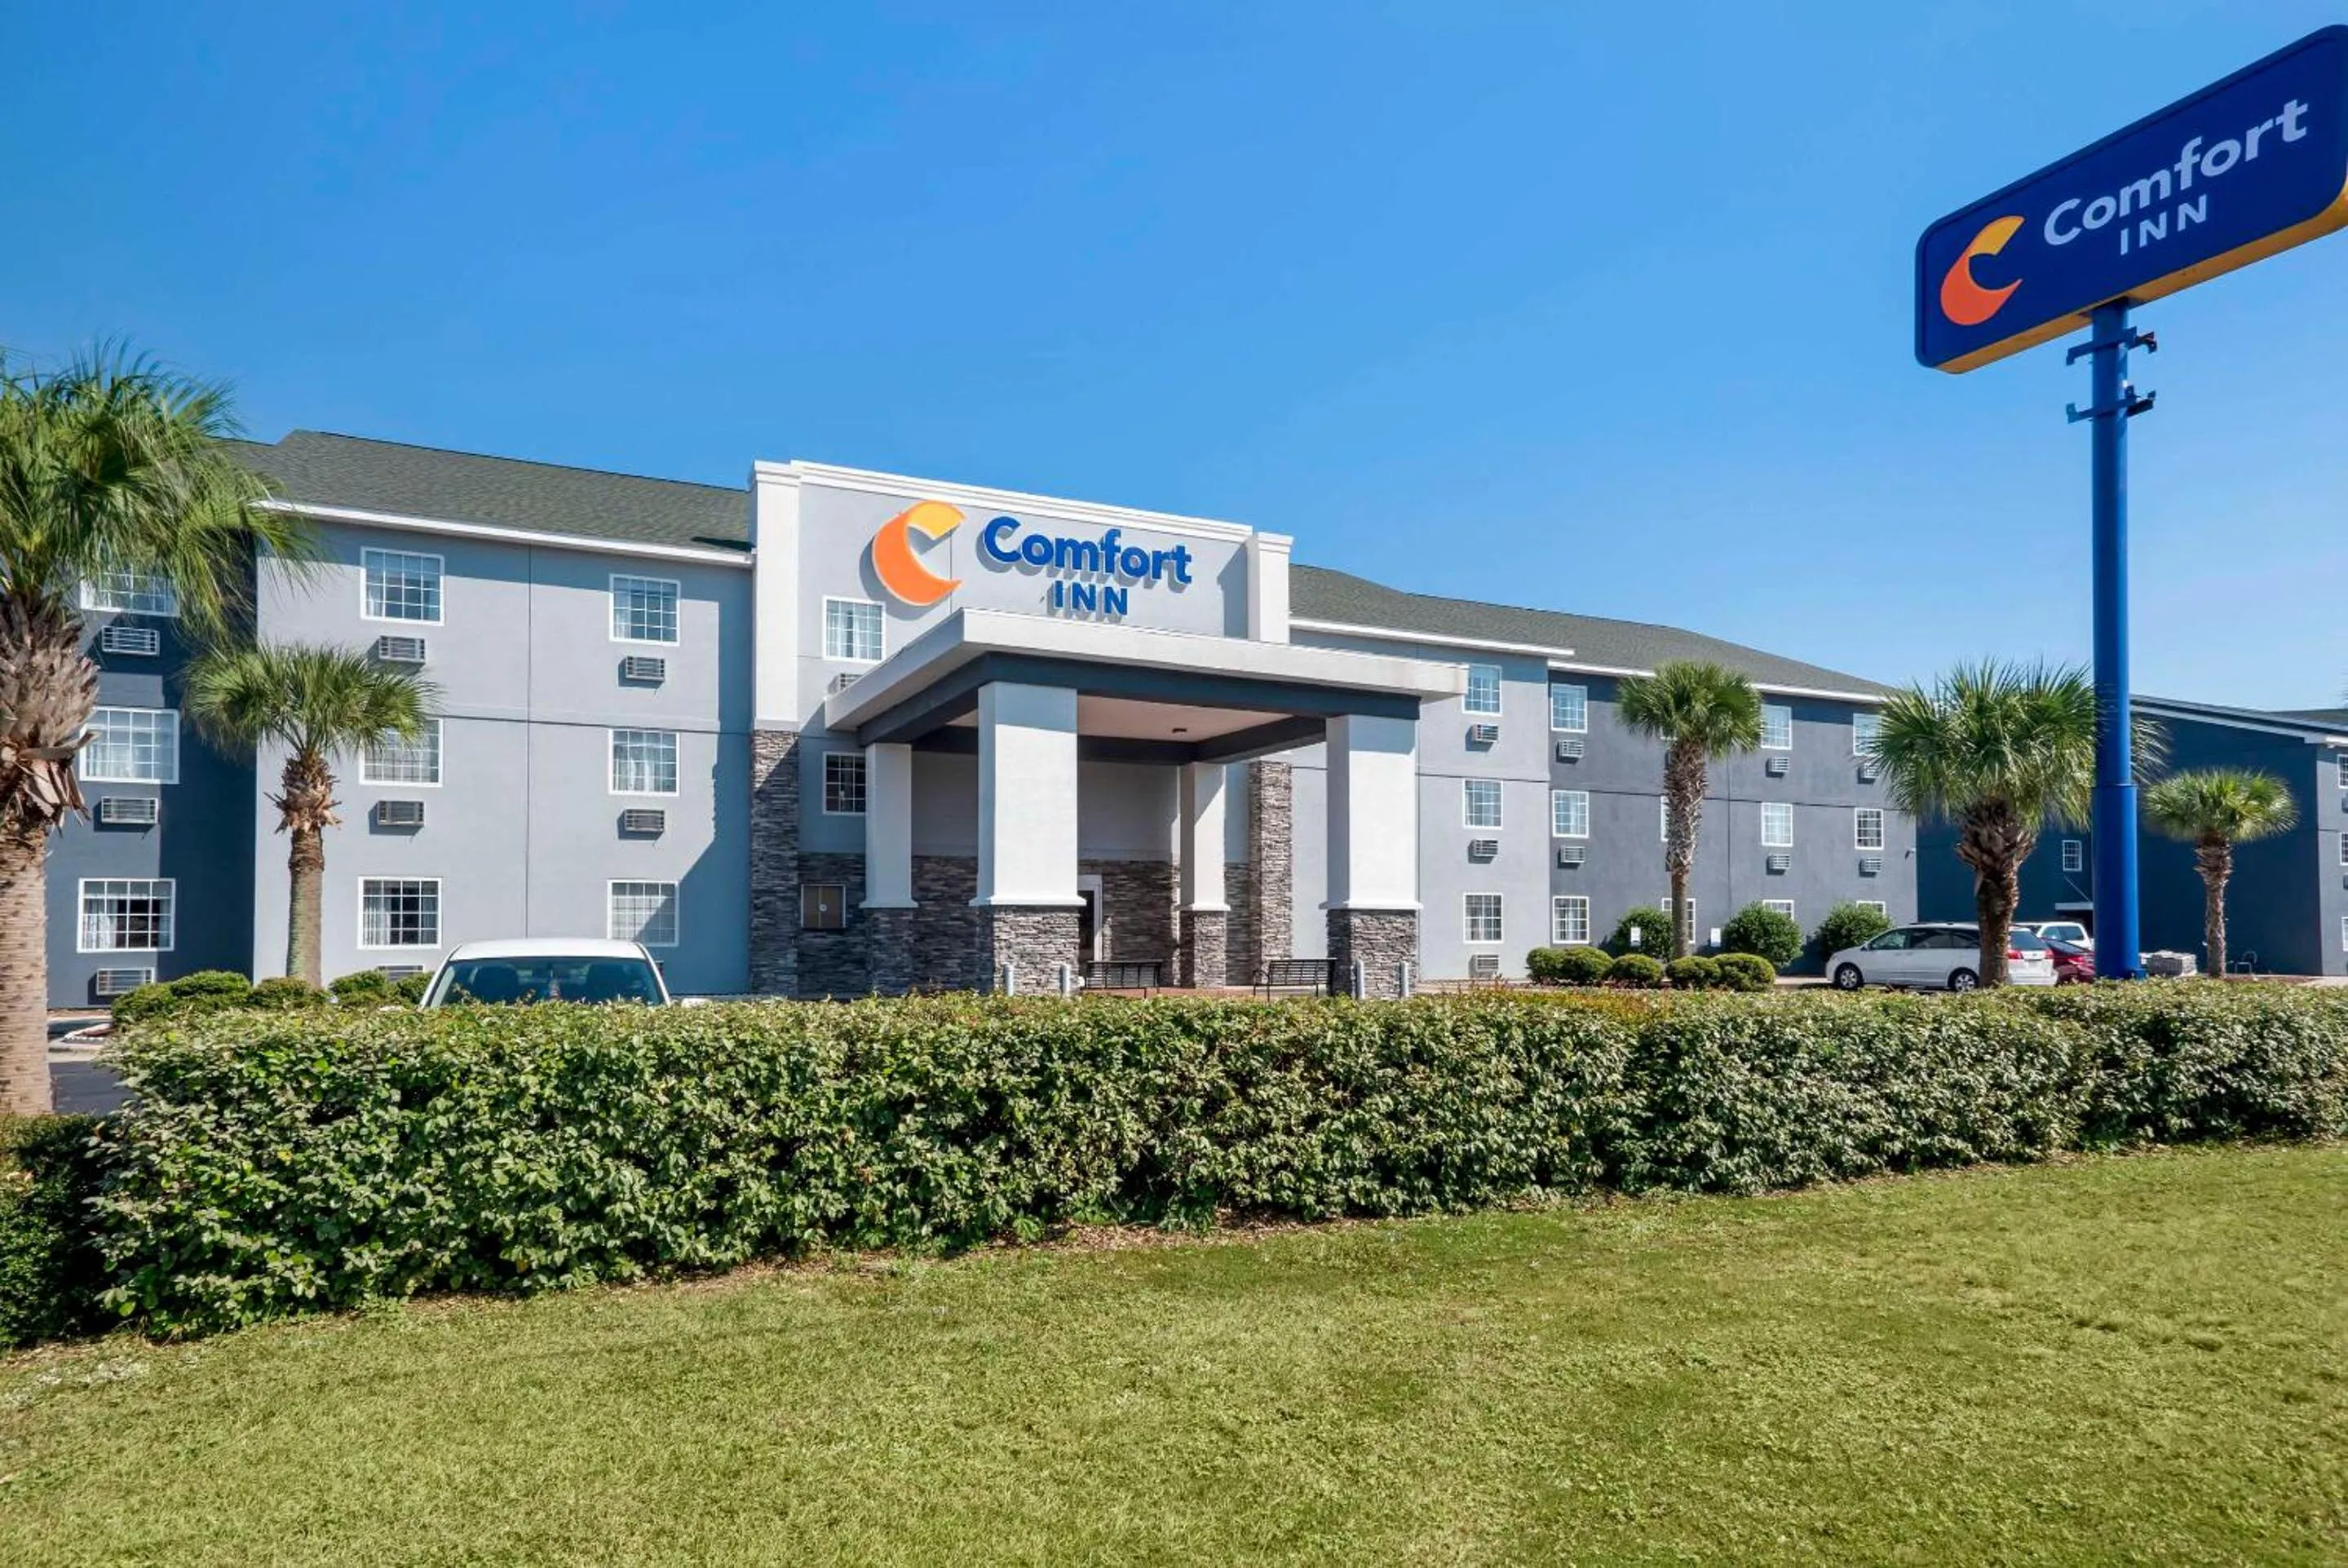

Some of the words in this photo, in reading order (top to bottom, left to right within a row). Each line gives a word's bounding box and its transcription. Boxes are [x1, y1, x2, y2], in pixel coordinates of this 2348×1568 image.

[2043, 98, 2309, 247] Comfort
[2119, 193, 2208, 256] INN
[983, 515, 1193, 585] Comfort
[1054, 580, 1129, 616] INN
